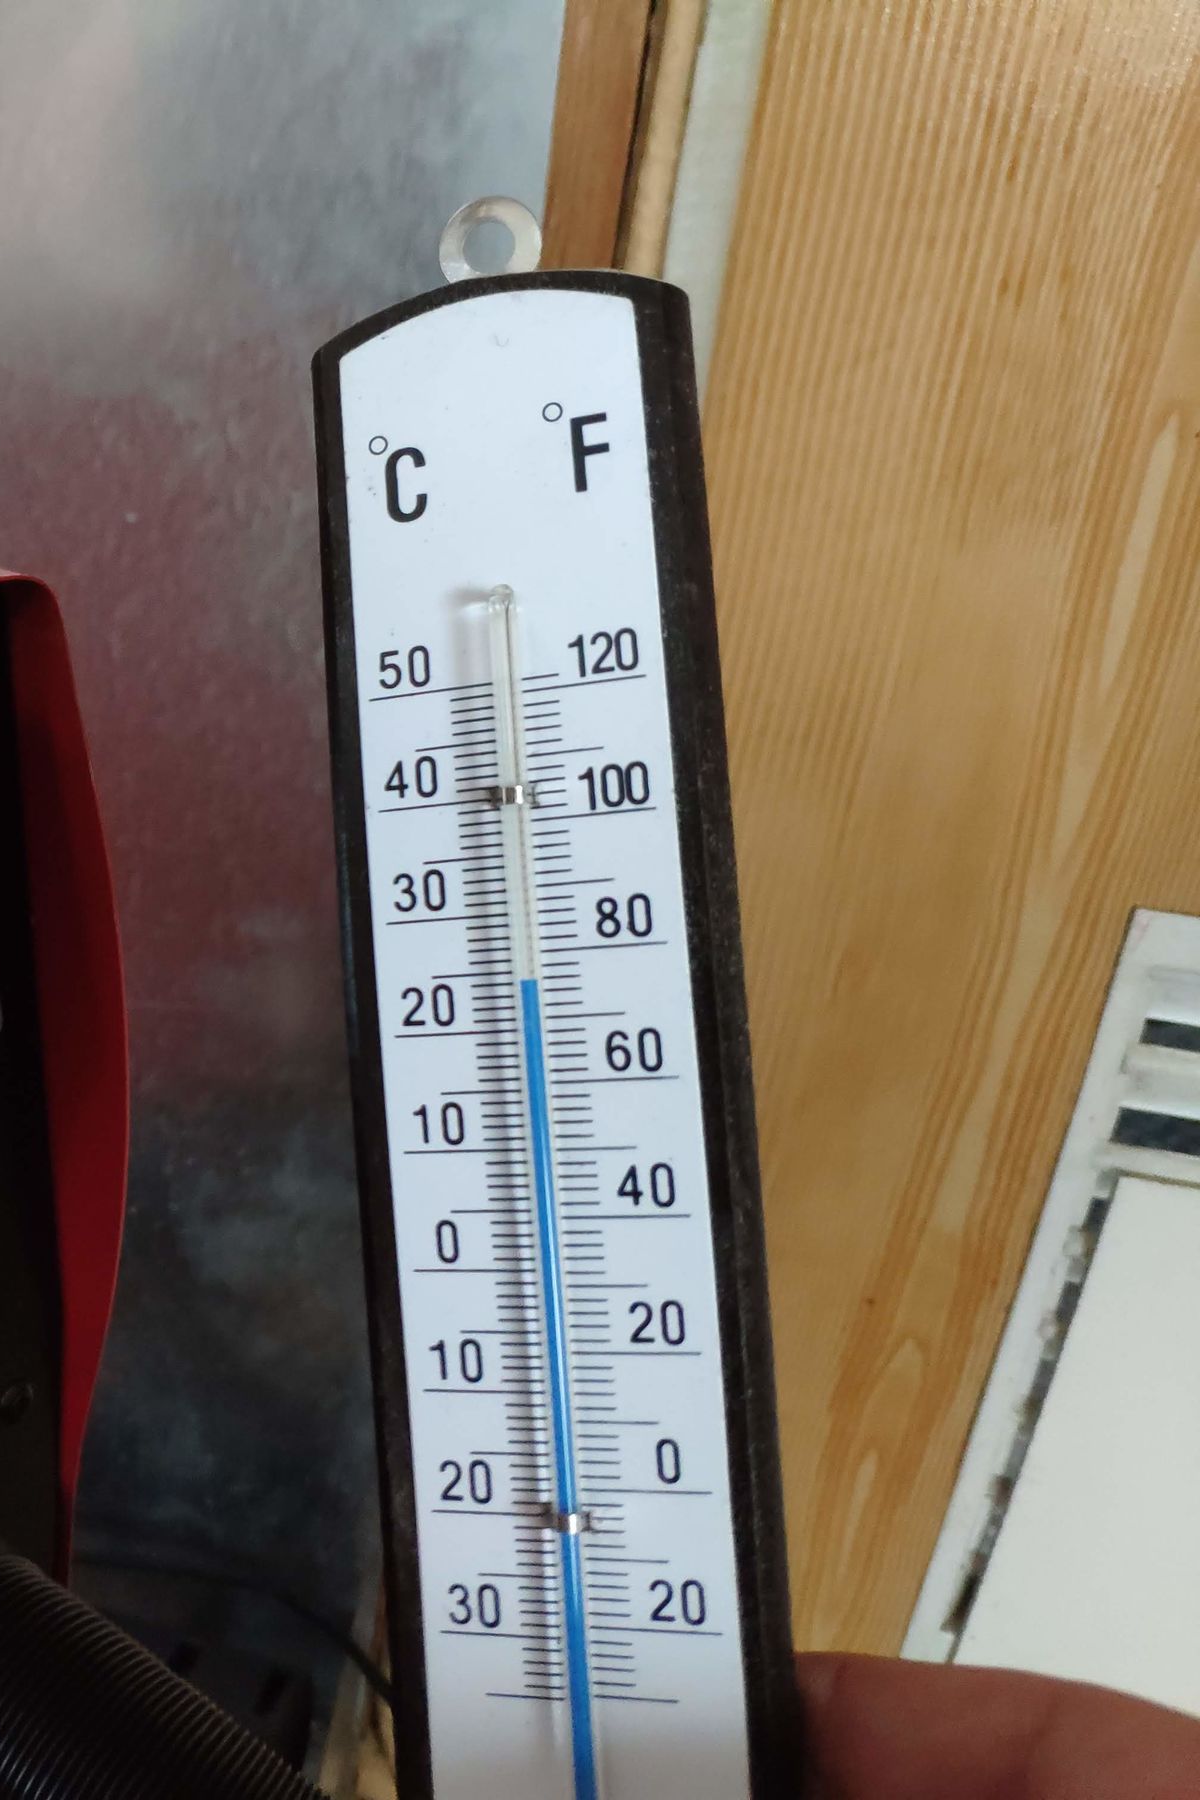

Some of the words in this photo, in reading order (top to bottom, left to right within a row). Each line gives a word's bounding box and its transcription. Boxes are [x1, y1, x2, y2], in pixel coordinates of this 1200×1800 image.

[379, 645, 431, 690] 50
[568, 627, 639, 678] 120
[384, 755, 438, 799] 40
[578, 761, 650, 811] 100
[393, 868, 446, 913] 30
[595, 893, 653, 939] 80
[401, 983, 455, 1027] 20
[605, 1027, 663, 1073] 60
[413, 1101, 465, 1146] 10
[617, 1162, 676, 1208] 40
[435, 1219, 460, 1264] 0
[628, 1300, 686, 1346] 20
[429, 1338, 484, 1384] 10
[439, 1459, 493, 1505] 20
[655, 1438, 681, 1485] 0
[448, 1583, 501, 1629] 30
[649, 1579, 706, 1626] 20
